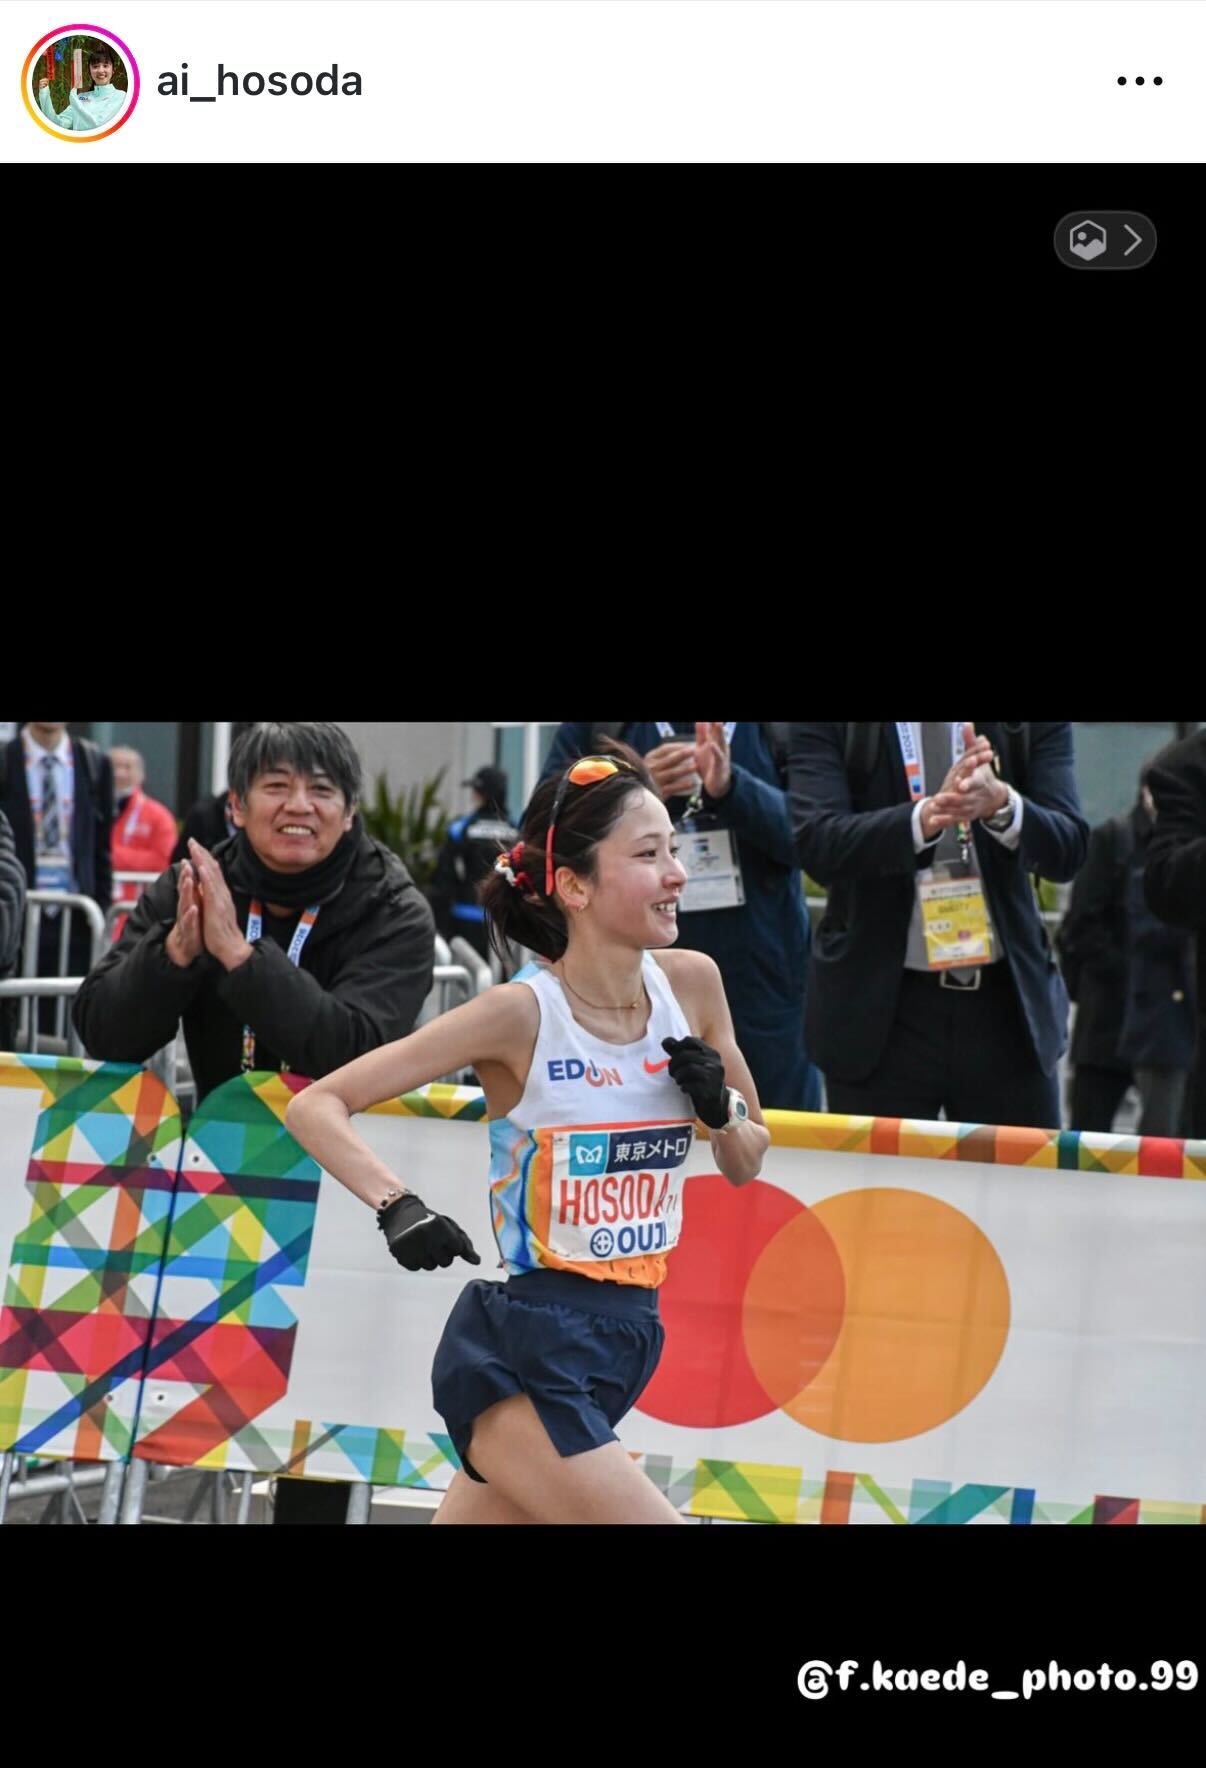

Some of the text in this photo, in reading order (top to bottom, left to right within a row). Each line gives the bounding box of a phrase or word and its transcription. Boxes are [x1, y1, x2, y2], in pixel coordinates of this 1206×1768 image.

[614, 1137, 688, 1163] 東京メトロ
[558, 1172, 670, 1227] HOSODA
